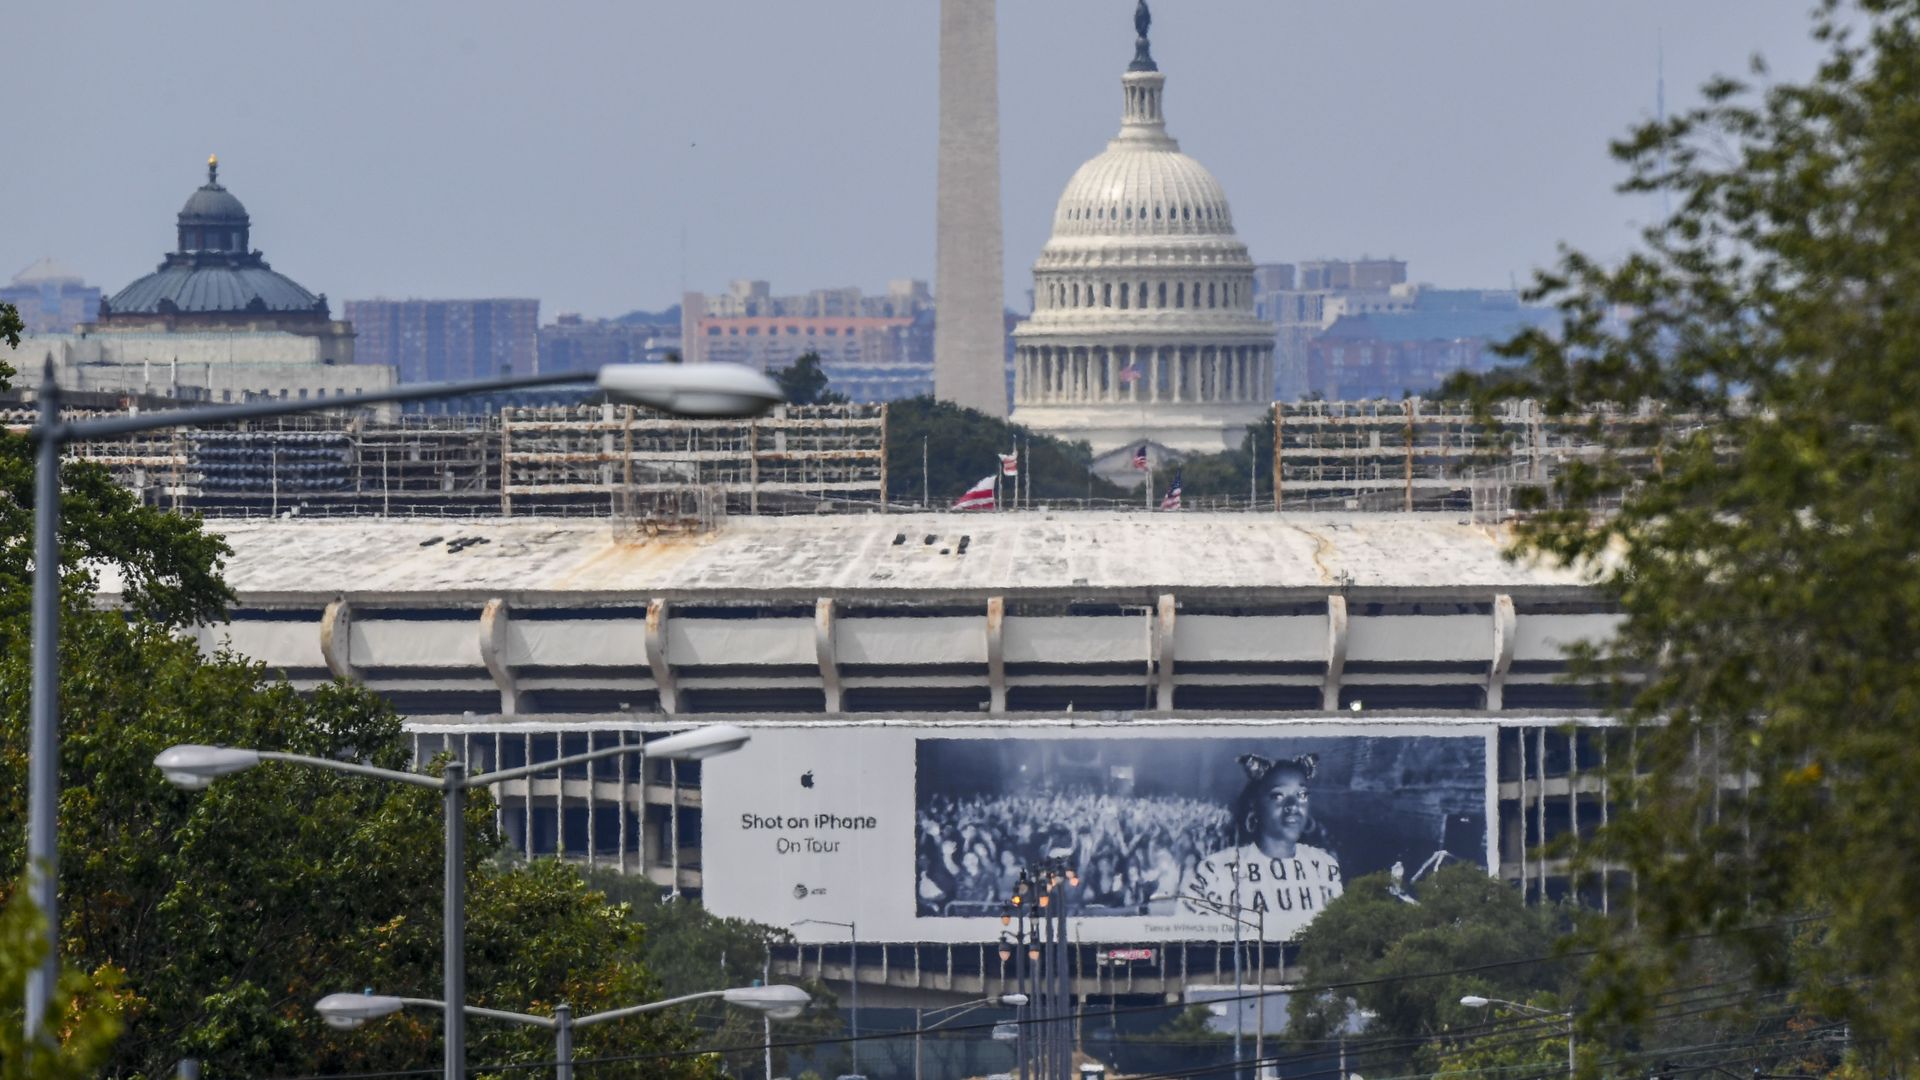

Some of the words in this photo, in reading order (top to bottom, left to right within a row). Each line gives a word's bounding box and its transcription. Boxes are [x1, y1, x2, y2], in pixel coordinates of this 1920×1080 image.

[741, 813, 783, 829] Shot
[787, 816, 809, 829] on
[814, 813, 877, 830] iPhone
[776, 837, 801, 854] On
[804, 837, 840, 853] Tour
